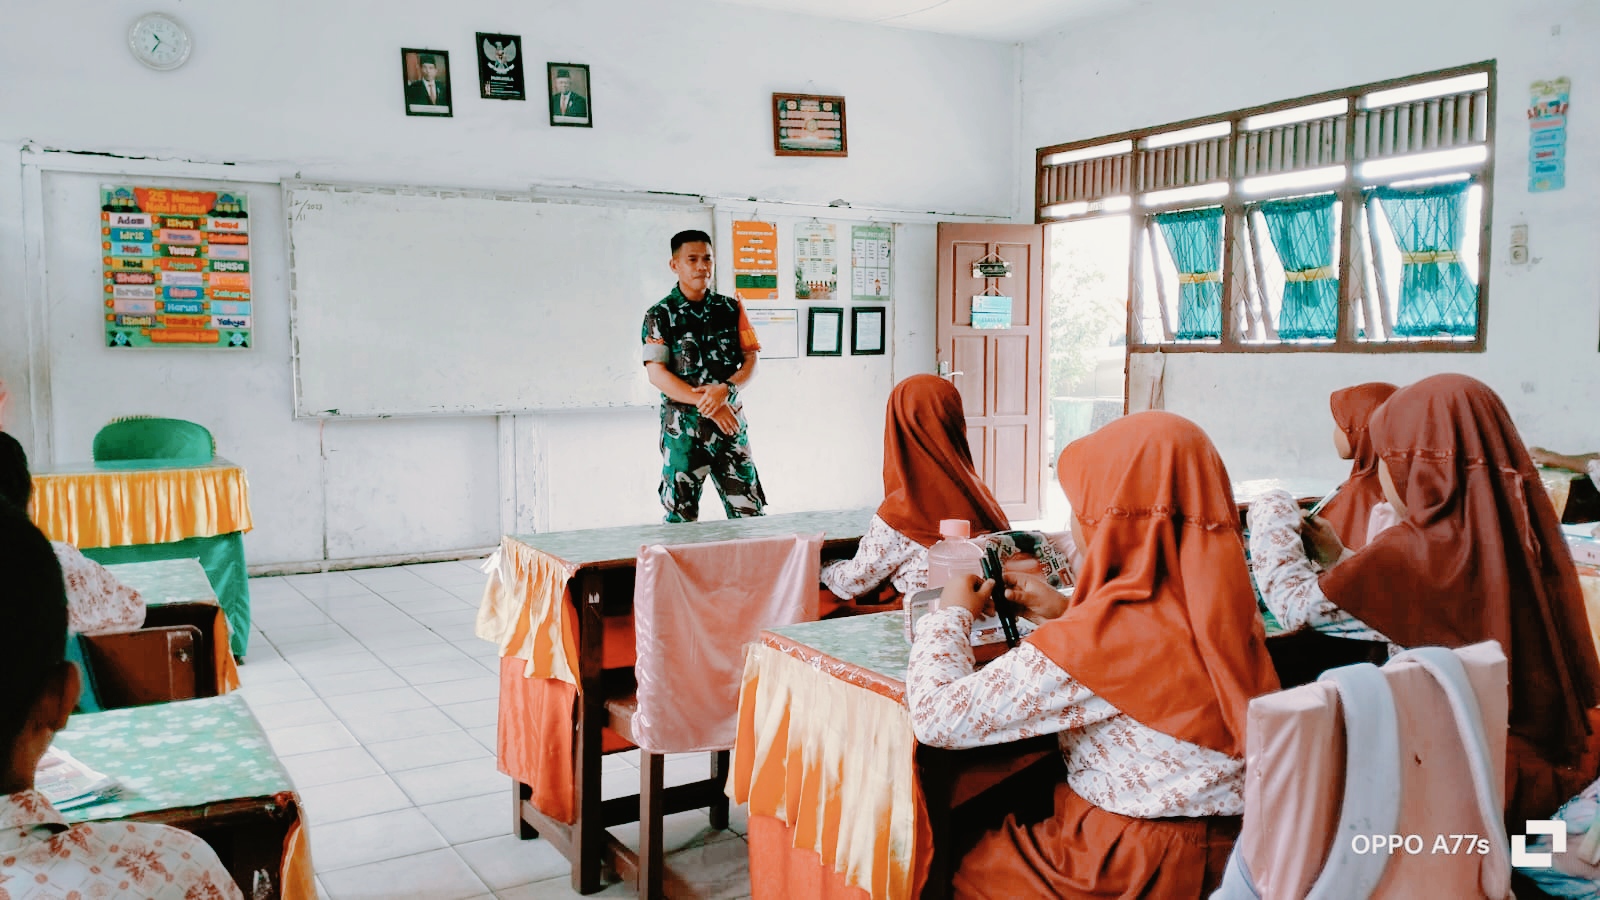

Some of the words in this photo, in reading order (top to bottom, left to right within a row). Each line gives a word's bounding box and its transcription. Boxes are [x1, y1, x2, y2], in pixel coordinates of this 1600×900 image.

[149, 190, 167, 202] 25
[117, 216, 144, 225] Adam
[167, 303, 198, 313] Harun
[217, 318, 245, 328] Yahya
